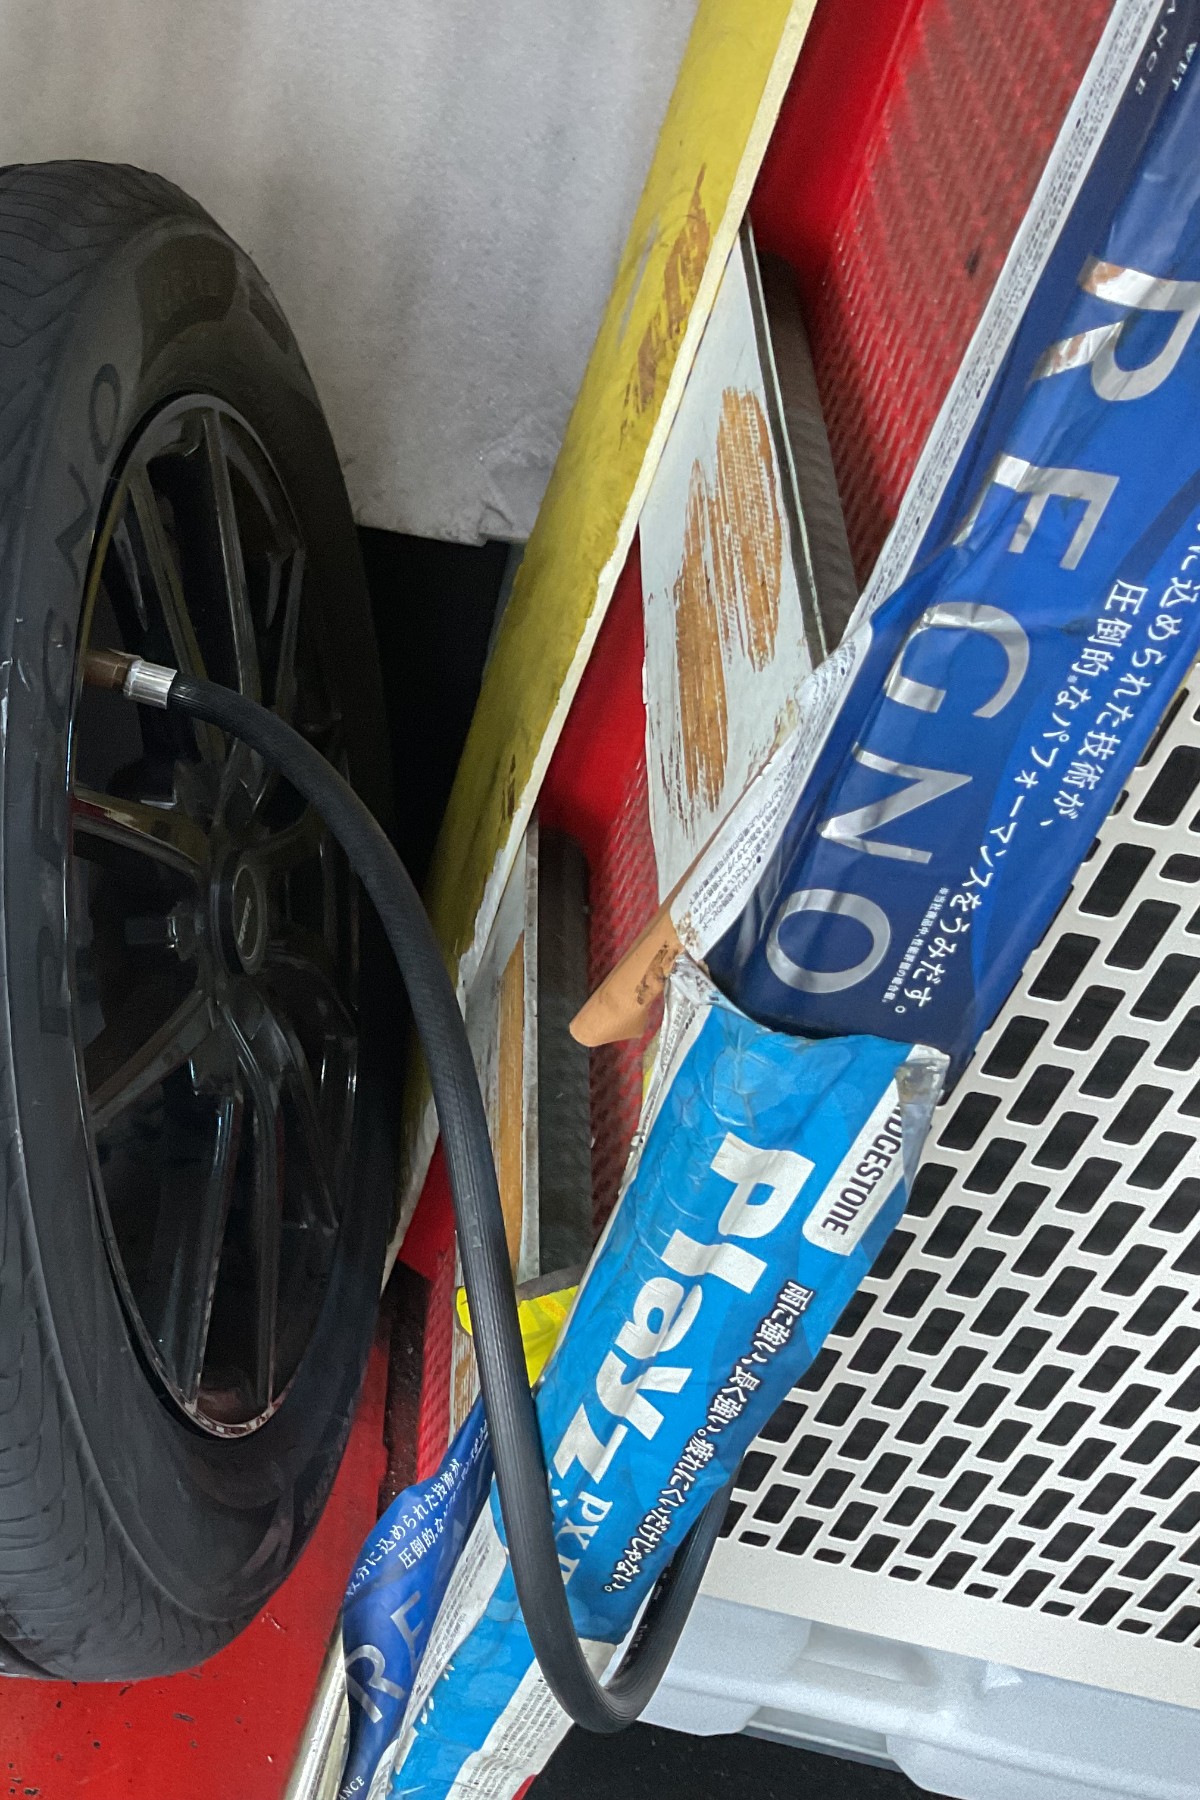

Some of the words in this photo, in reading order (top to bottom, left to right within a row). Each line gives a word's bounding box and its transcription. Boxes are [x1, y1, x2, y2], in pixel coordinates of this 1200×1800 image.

[765, 255, 1200, 994] REGNO
[1039, 518, 1200, 828] に込められた技術が、
[550, 1132, 816, 1485] Playz
[562, 1491, 613, 1549] PX
